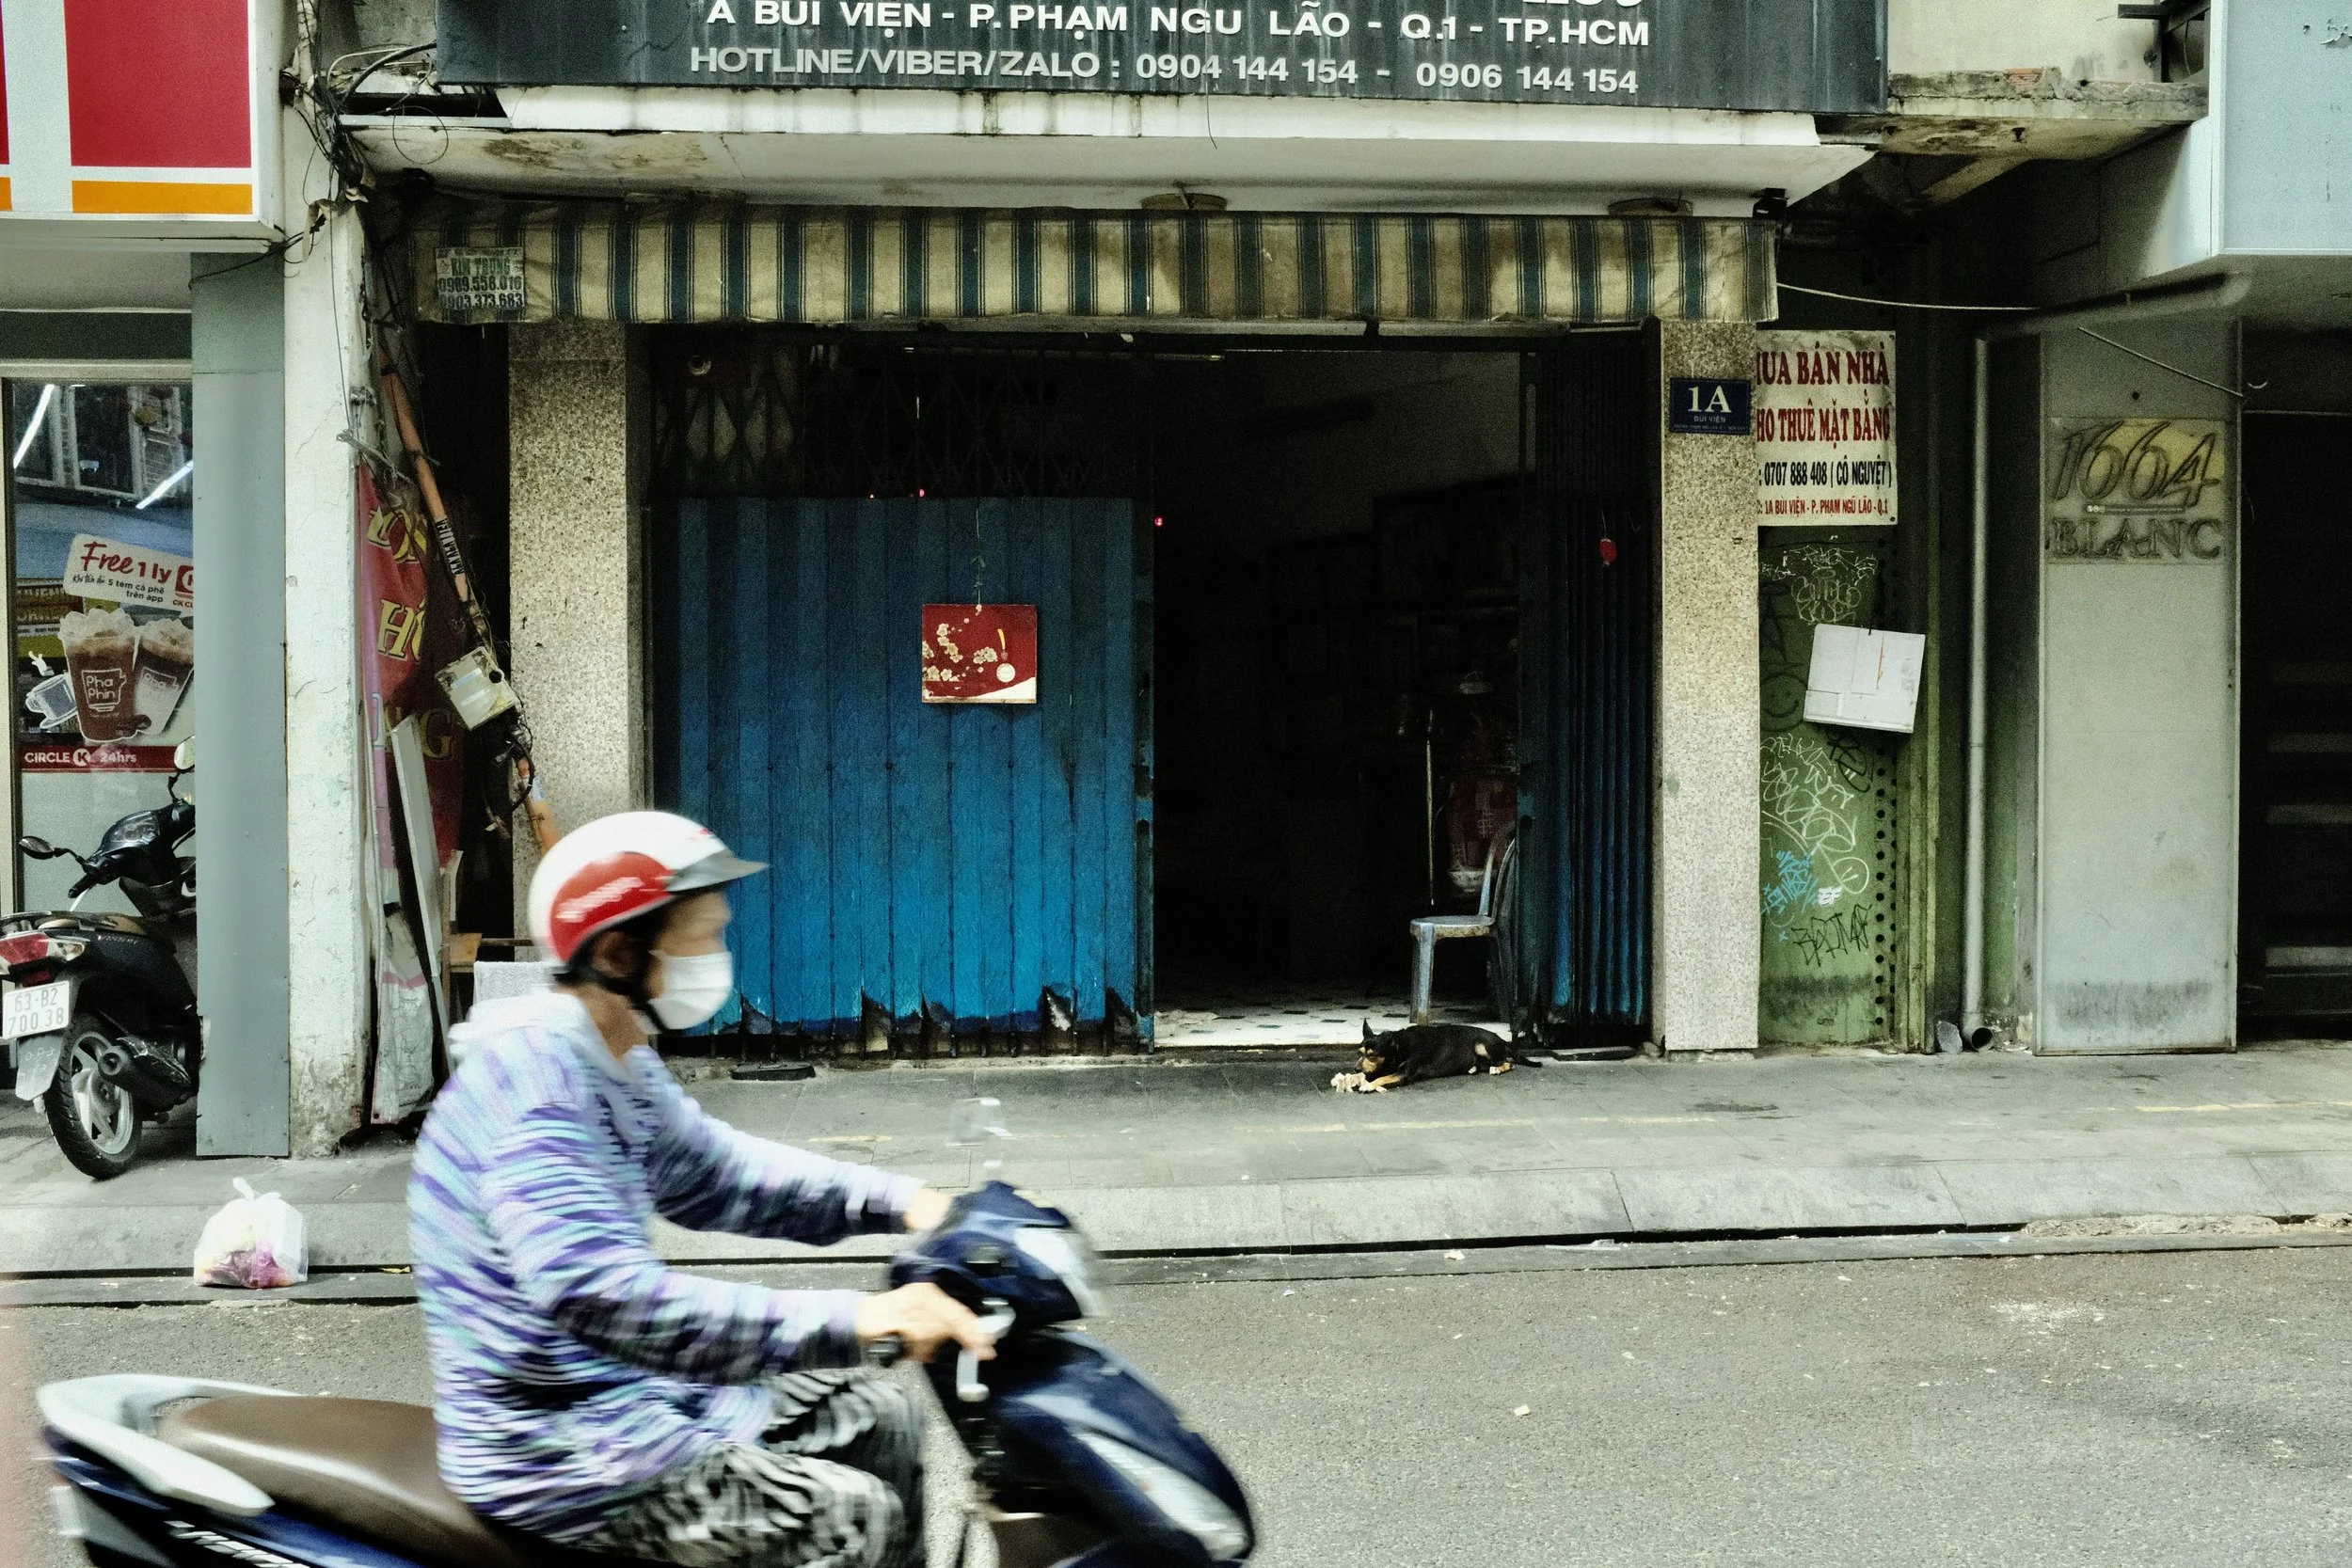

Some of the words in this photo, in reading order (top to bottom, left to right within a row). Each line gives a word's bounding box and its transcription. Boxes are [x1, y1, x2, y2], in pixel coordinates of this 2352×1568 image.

[1269, 0, 1350, 38] LÃO
[1400, 14, 1456, 40] Q.1
[1498, 18, 1649, 46] TP.HCM
[1136, 54, 1223, 79] 0904
[1232, 55, 1289, 81] 144
[1301, 58, 1359, 84] 154
[1416, 62, 1502, 88] 0906
[1516, 66, 1574, 91] 144
[1582, 69, 1639, 94] 154
[1796, 341, 1840, 385] BÁN
[1846, 341, 1890, 385] NHÀ
[1688, 385, 1732, 413] 1A
[1778, 398, 1816, 442] THUÊ
[1819, 398, 1850, 450] MẶT
[1764, 461, 1788, 486] 0707
[1789, 461, 1808, 486] 888
[1810, 461, 1827, 486] 408
[2052, 420, 2220, 508] 1664
[1764, 499, 1773, 515] 1A
[1775, 496, 1788, 515] BÙI
[1788, 496, 1805, 517] VIỆN
[1820, 499, 1840, 516] PHẠM
[1858, 496, 1872, 515] LÃO
[1877, 499, 1888, 516] Q.1
[2051, 517, 2222, 560] BLANC
[80, 541, 135, 575] Free
[151, 562, 172, 584] ly
[116, 580, 133, 590] tem
[126, 590, 145, 599] trên
[146, 594, 164, 603] app
[86, 674, 113, 688] Pha
[87, 688, 116, 700] Phin
[24, 752, 71, 764] CIRCLE
[100, 752, 137, 764] 24hrs
[14, 987, 58, 1013] 63-B2
[8, 1006, 64, 1036] 700.38
